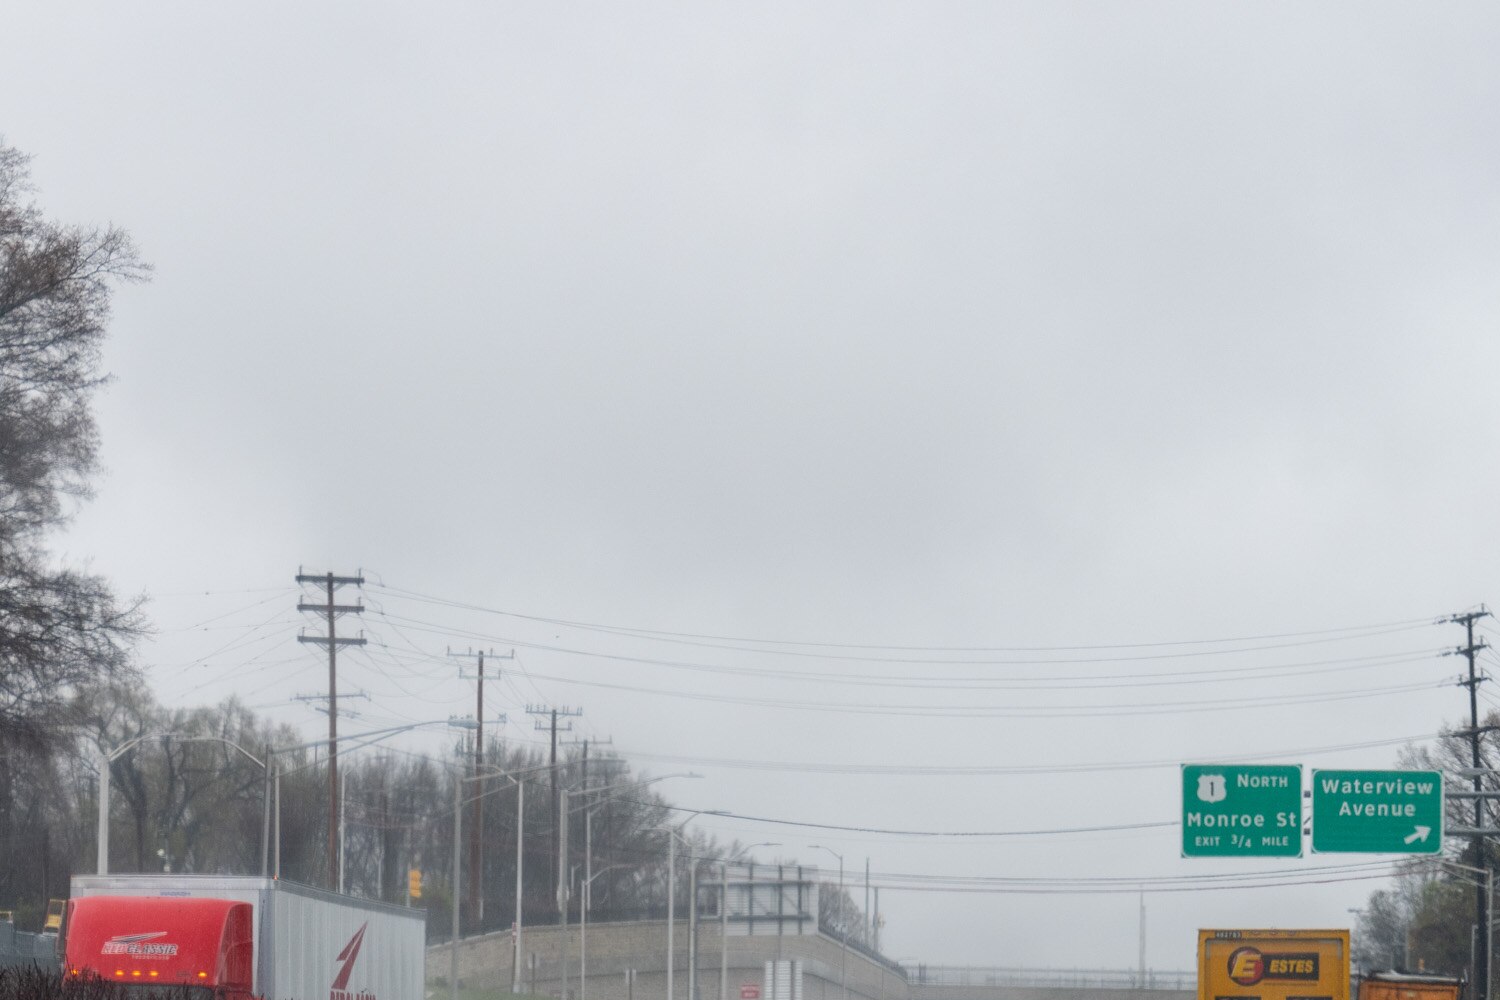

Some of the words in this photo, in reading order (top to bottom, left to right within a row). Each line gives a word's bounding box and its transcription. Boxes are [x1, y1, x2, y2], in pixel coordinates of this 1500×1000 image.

[1209, 781, 1215, 796] 1
[1237, 774, 1288, 788] NORTH
[1322, 779, 1433, 794] Waterview
[1338, 801, 1416, 816] Avenue
[1187, 812, 1265, 827] Monroe
[1277, 812, 1297, 827] St
[1195, 836, 1220, 846] EXIT
[1262, 836, 1289, 846] MILE
[1269, 959, 1313, 973] ESTES
